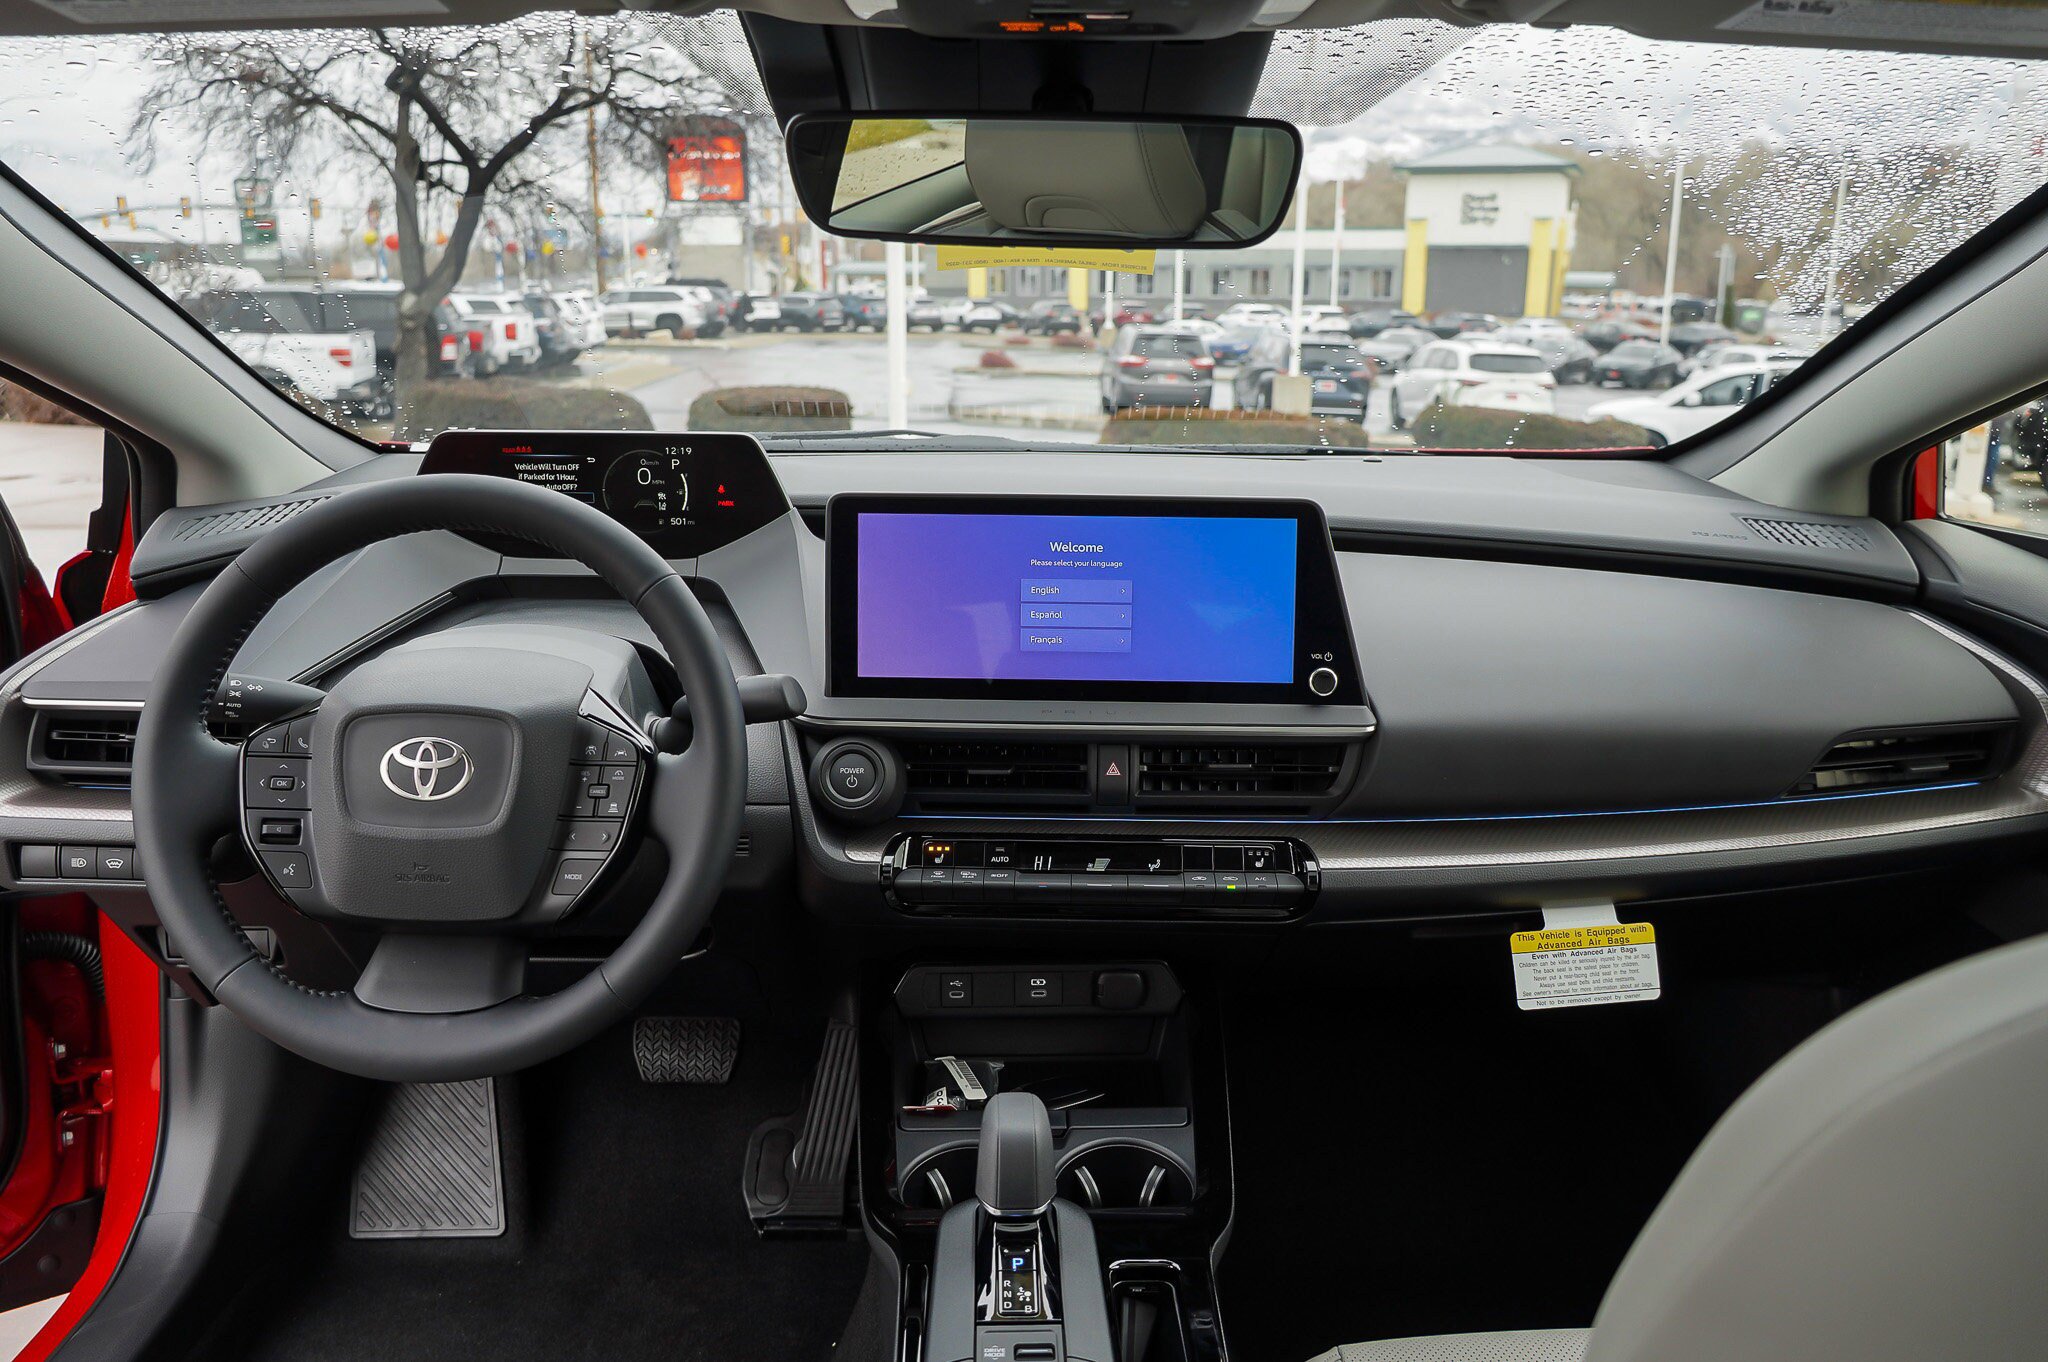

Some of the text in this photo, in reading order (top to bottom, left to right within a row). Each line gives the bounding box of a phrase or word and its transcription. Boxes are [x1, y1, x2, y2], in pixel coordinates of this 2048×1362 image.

[672, 459, 680, 470] P
[638, 468, 651, 484] 0
[1050, 542, 1104, 552] Welcome
[1090, 560, 1123, 568] language
[1030, 586, 1060, 595] English
[1030, 611, 1062, 620] Español
[1030, 636, 1062, 645] Français
[1034, 856, 1052, 870] HI
[395, 874, 450, 884] SRS AIRBAG
[1539, 932, 1570, 940] Vehicle
[1587, 927, 1626, 937] Equipped
[1630, 925, 1647, 933] with
[1537, 940, 1582, 950] Advanced
[1608, 937, 1630, 945] Bags
[1570, 949, 1603, 957] Advanced
[1012, 1258, 1024, 1271] P
[1004, 1290, 1012, 1298] N
[1024, 1305, 1032, 1313] B
